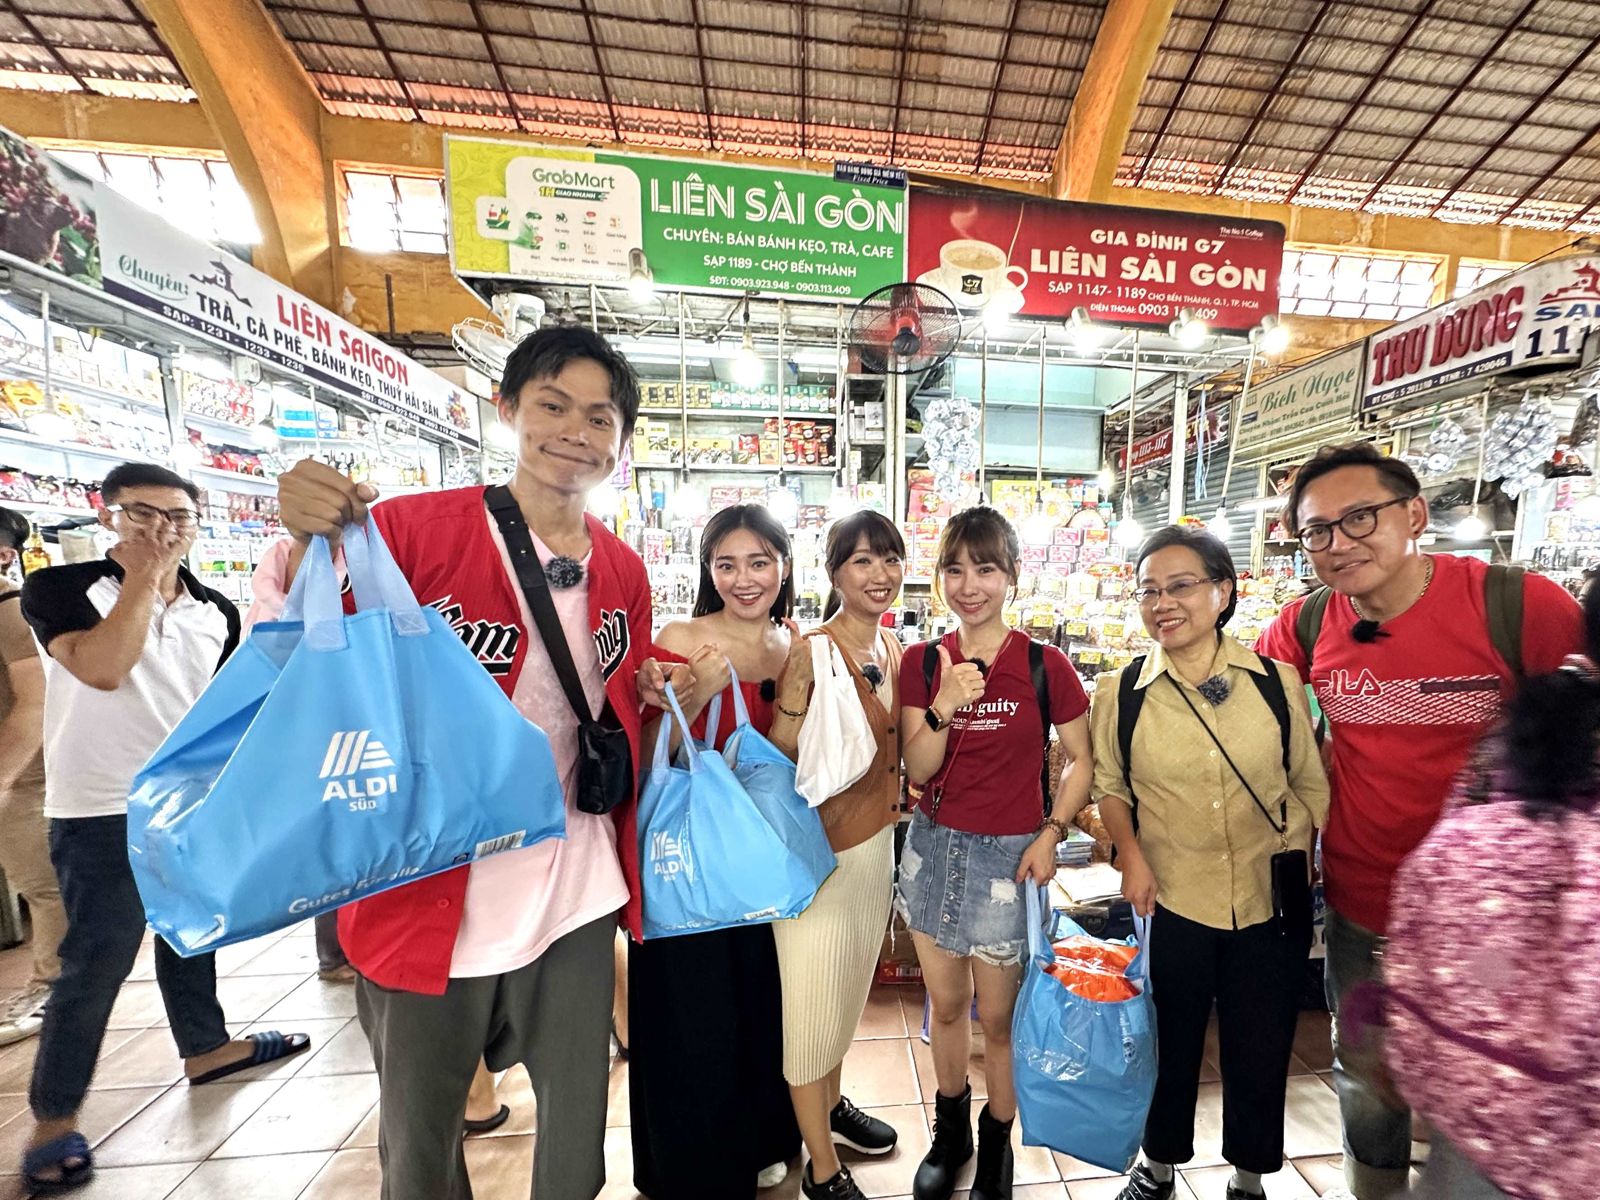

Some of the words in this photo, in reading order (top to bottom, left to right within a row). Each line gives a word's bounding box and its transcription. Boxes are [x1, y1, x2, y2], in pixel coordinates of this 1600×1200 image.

[532, 168, 615, 189] GrabMart
[650, 172, 735, 219] LIÊN
[745, 181, 805, 225] SÀI
[814, 188, 903, 234] GÒN
[663, 227, 724, 244] CHUYÊN:
[727, 233, 754, 247] BÁN
[758, 233, 796, 250] BÁNH
[799, 239, 828, 255] KẸO,
[831, 240, 859, 257] TRÀ,
[862, 244, 894, 259] CAFE
[1090, 229, 1129, 246] GIA
[1135, 230, 1188, 251] ĐÌNH
[1194, 238, 1225, 255] G7
[119, 254, 189, 295] Chuyên:
[703, 255, 726, 269] SẠP
[728, 257, 752, 269] 1189
[761, 259, 788, 274] CHỢ
[790, 259, 813, 274] BẾN
[815, 261, 857, 278] THÀNH
[1030, 245, 1107, 278] LIÊN
[1119, 253, 1177, 284] SÀI
[1189, 259, 1267, 292] GÒN
[730, 276, 790, 290] 0903.923.948
[795, 282, 851, 295] 0903.113.409
[1048, 281, 1073, 295] SẠP
[1116, 285, 1147, 299] 1189
[1138, 303, 1169, 316] 0903
[162, 305, 195, 327] SẠP:
[200, 322, 230, 340] 1231
[245, 340, 270, 358] 1233
[196, 291, 241, 331] TRÀ,
[246, 316, 269, 341] CÀ
[273, 328, 308, 360] PHÊ,
[312, 346, 347, 377] BÁNH
[351, 365, 375, 391] KẸO,
[276, 294, 332, 347] LIÊN
[339, 330, 409, 385] SAIGON
[1372, 324, 1429, 385] THU
[1430, 286, 1525, 367] DUNG
[1314, 668, 1382, 697] FILA
[322, 774, 397, 801] ALDI
[349, 799, 377, 812] SÜD
